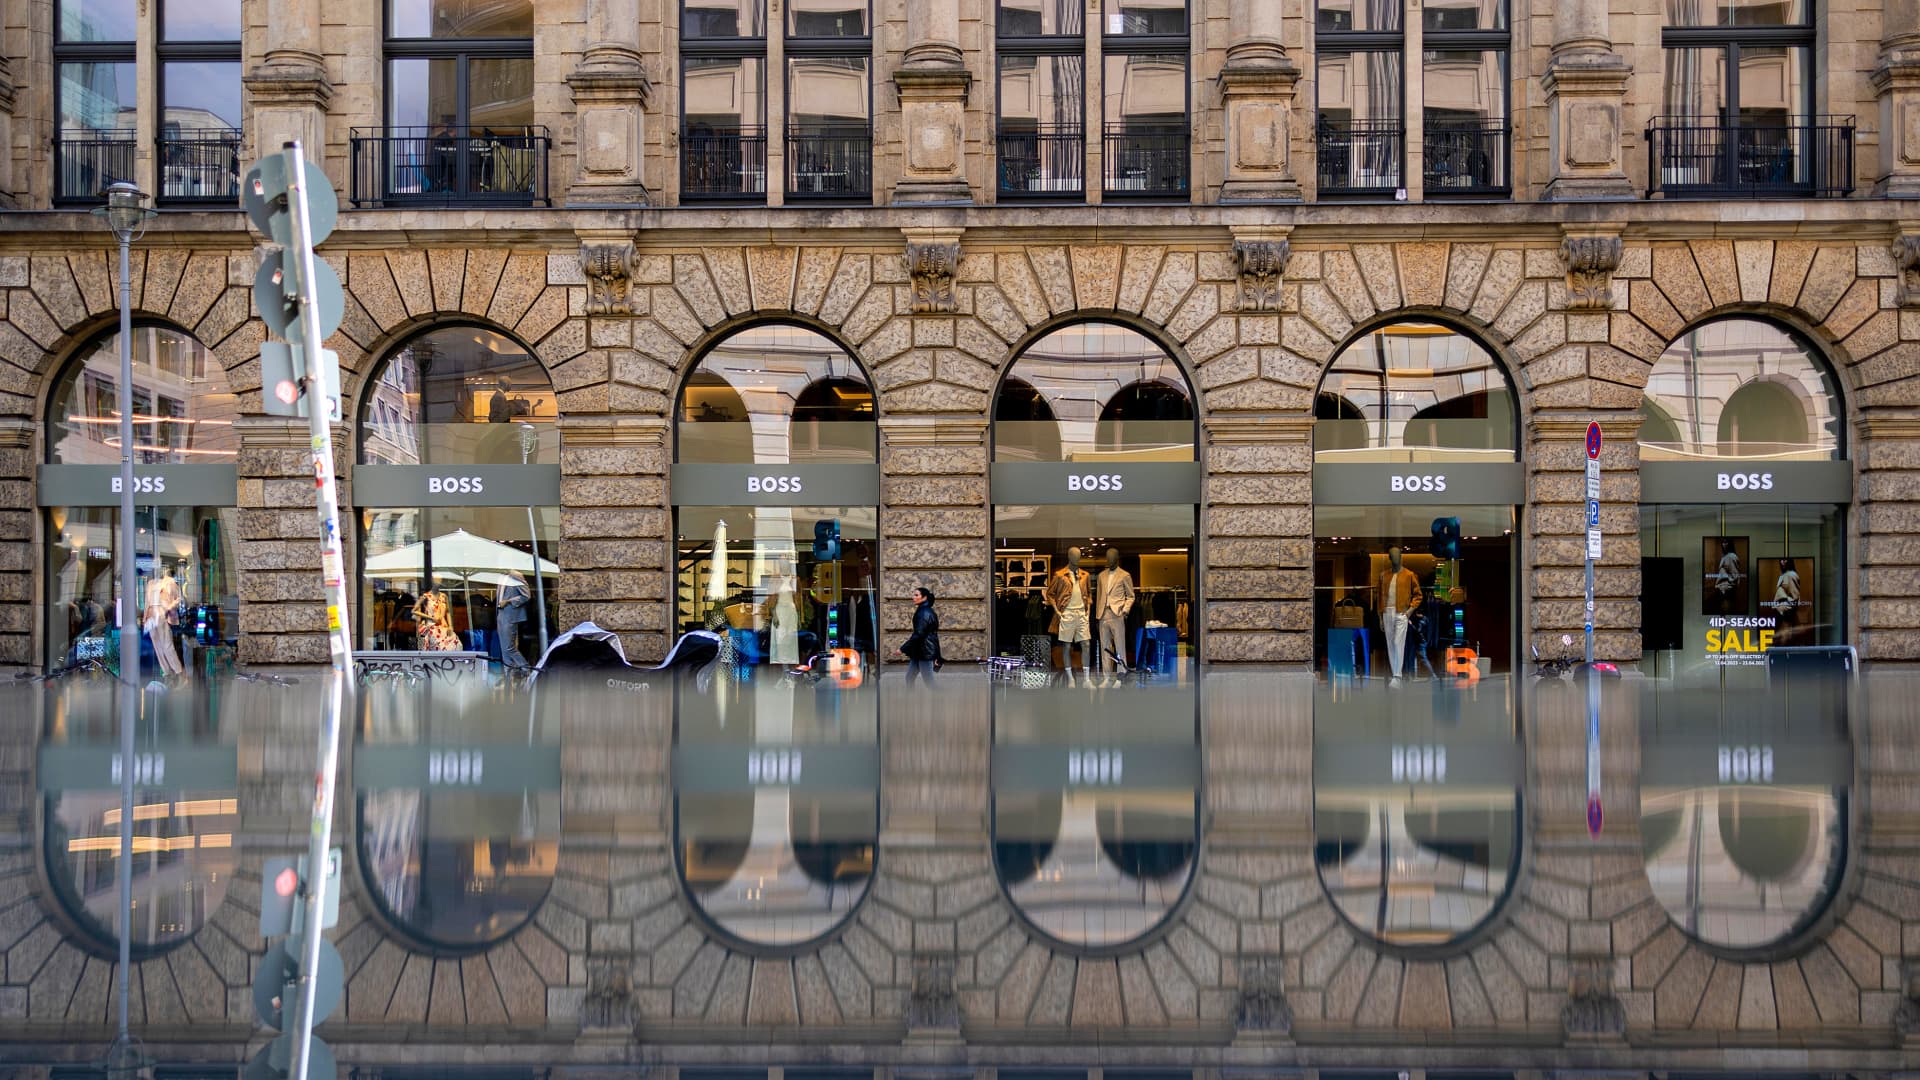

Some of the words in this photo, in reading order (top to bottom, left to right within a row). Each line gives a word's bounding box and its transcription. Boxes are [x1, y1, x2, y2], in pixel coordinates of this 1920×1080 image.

[429, 476, 484, 494] BOSS
[747, 476, 802, 493] BOSS
[1068, 474, 1123, 492] BOSS
[1391, 475, 1447, 492] BOSS
[1717, 473, 1773, 490] BOSS
[1705, 629, 1776, 652] SALE
